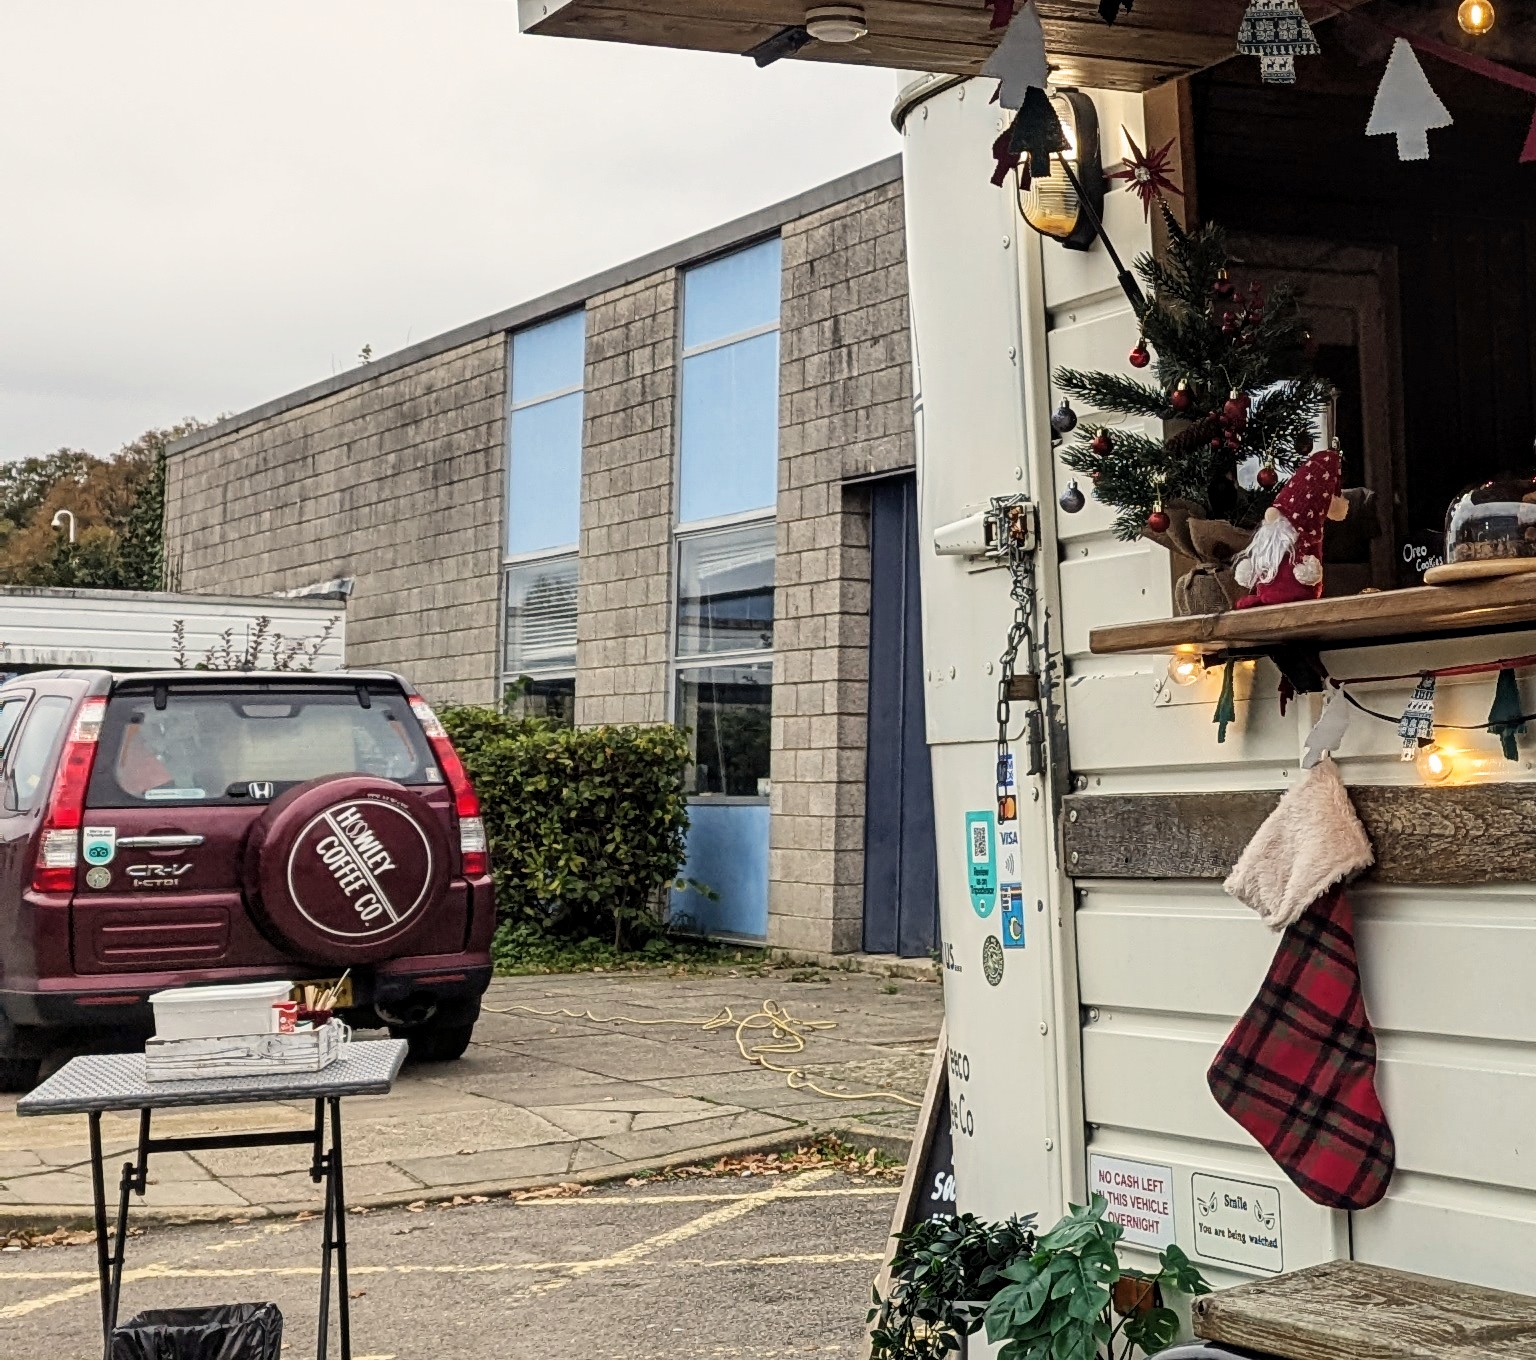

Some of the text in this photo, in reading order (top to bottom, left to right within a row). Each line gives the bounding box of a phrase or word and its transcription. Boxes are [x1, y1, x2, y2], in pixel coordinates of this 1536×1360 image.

[1402, 543, 1428, 563] Oreo
[335, 806, 396, 876] HOWLEY
[999, 831, 1019, 846] VISA
[125, 863, 193, 877] CR-V
[316, 836, 368, 897] COFFEE
[1098, 1169, 1164, 1194] NO CASH LEFT
[1107, 1191, 1128, 1207] THIS
[1130, 1195, 1169, 1215] VEHICLE
[1224, 1193, 1248, 1211] Smile
[1108, 1211, 1160, 1234] OVERNIGHT
[1198, 1222, 1212, 1235] You
[1214, 1227, 1225, 1238] are
[1227, 1227, 1246, 1245] being
